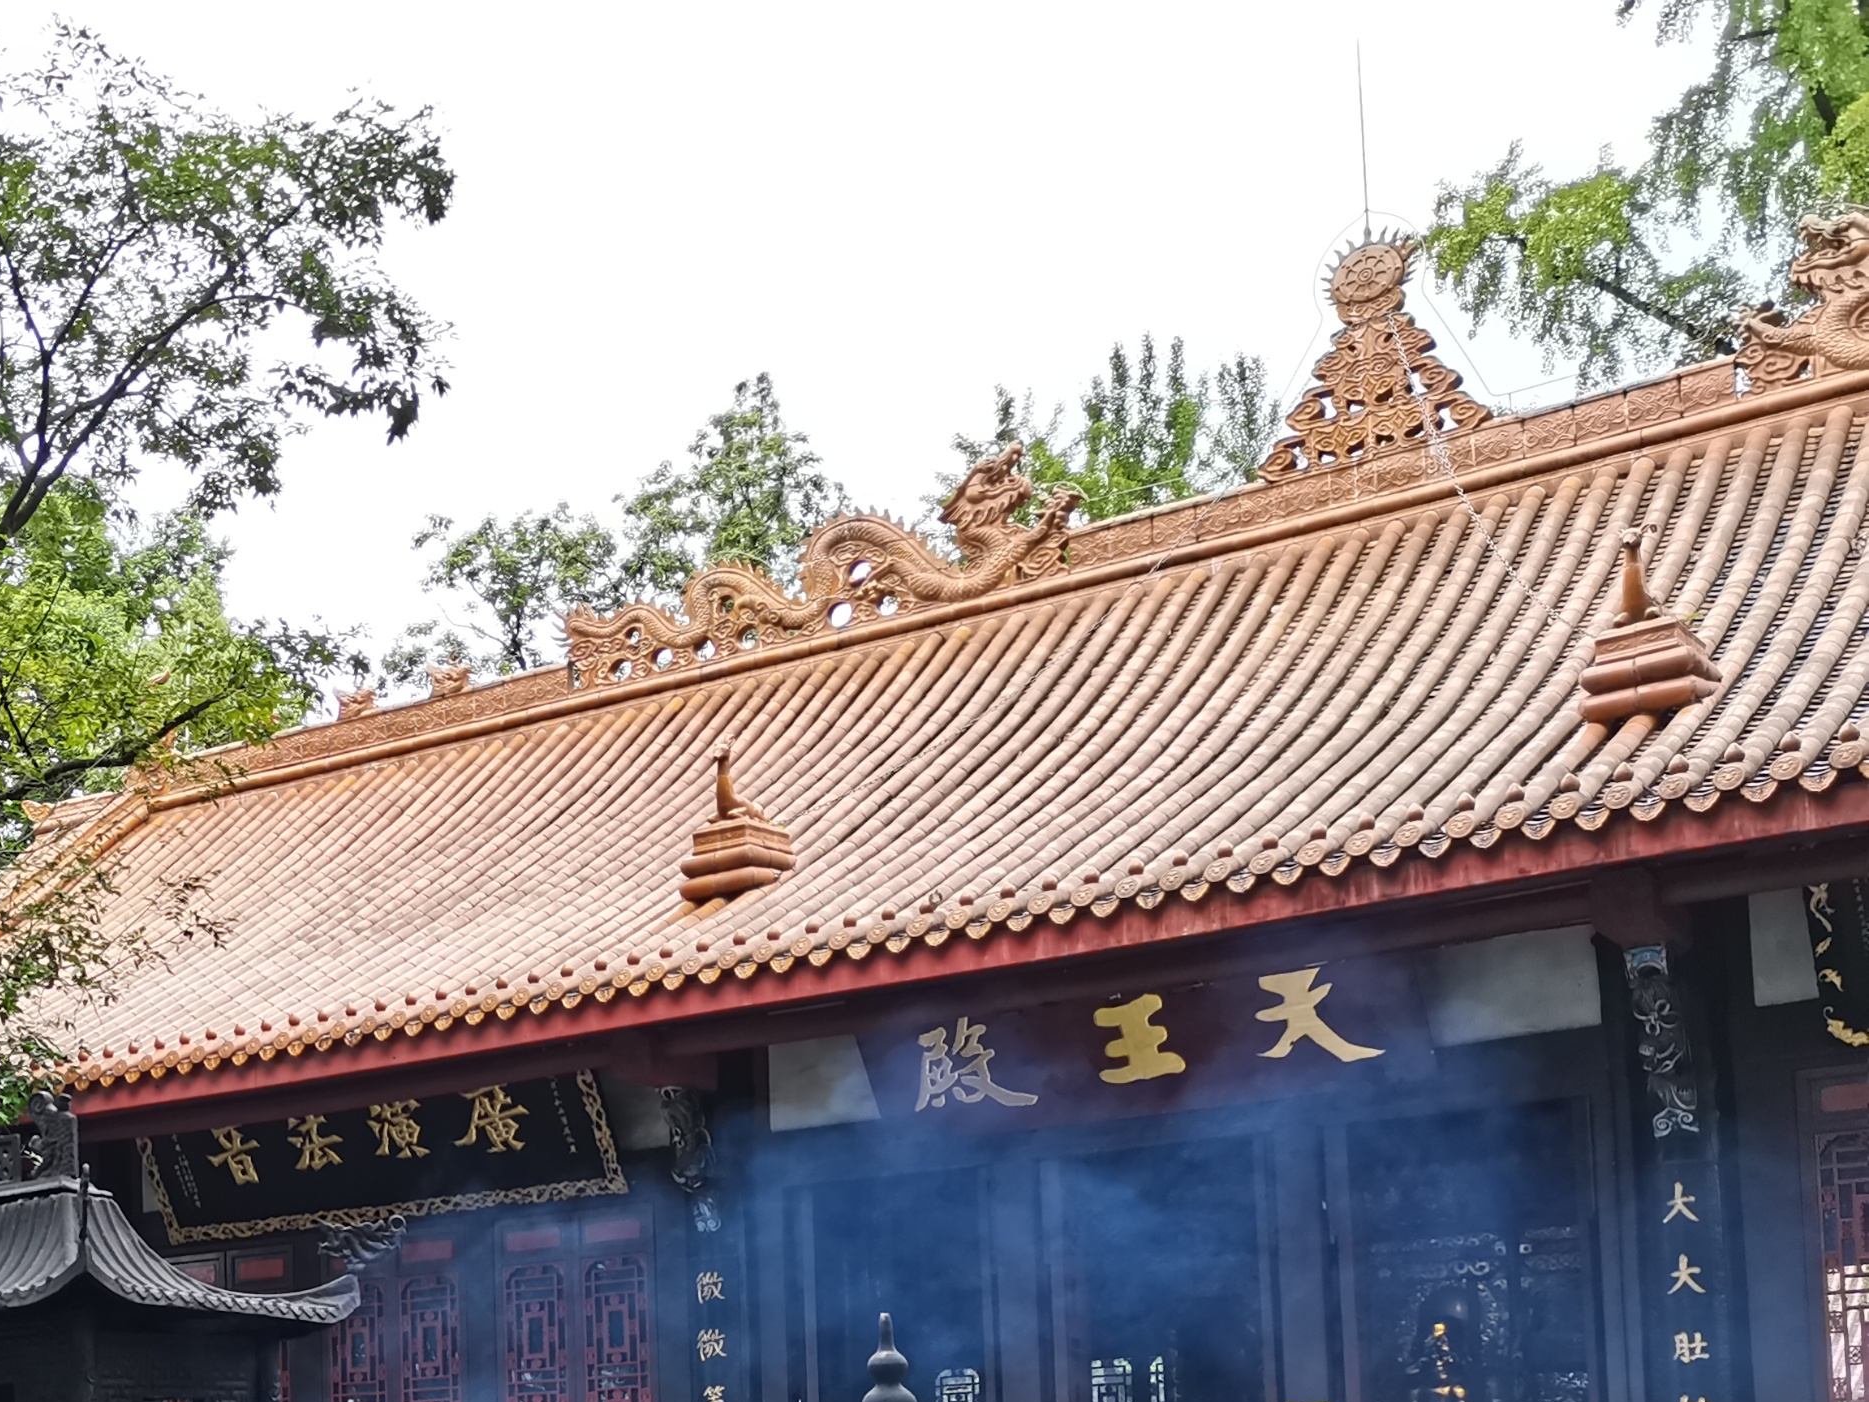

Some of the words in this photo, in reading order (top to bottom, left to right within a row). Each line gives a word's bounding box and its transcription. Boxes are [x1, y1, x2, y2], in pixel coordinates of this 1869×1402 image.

[915, 966, 1386, 1112] 天王殿
[207, 1084, 529, 1184] 廣演法音
